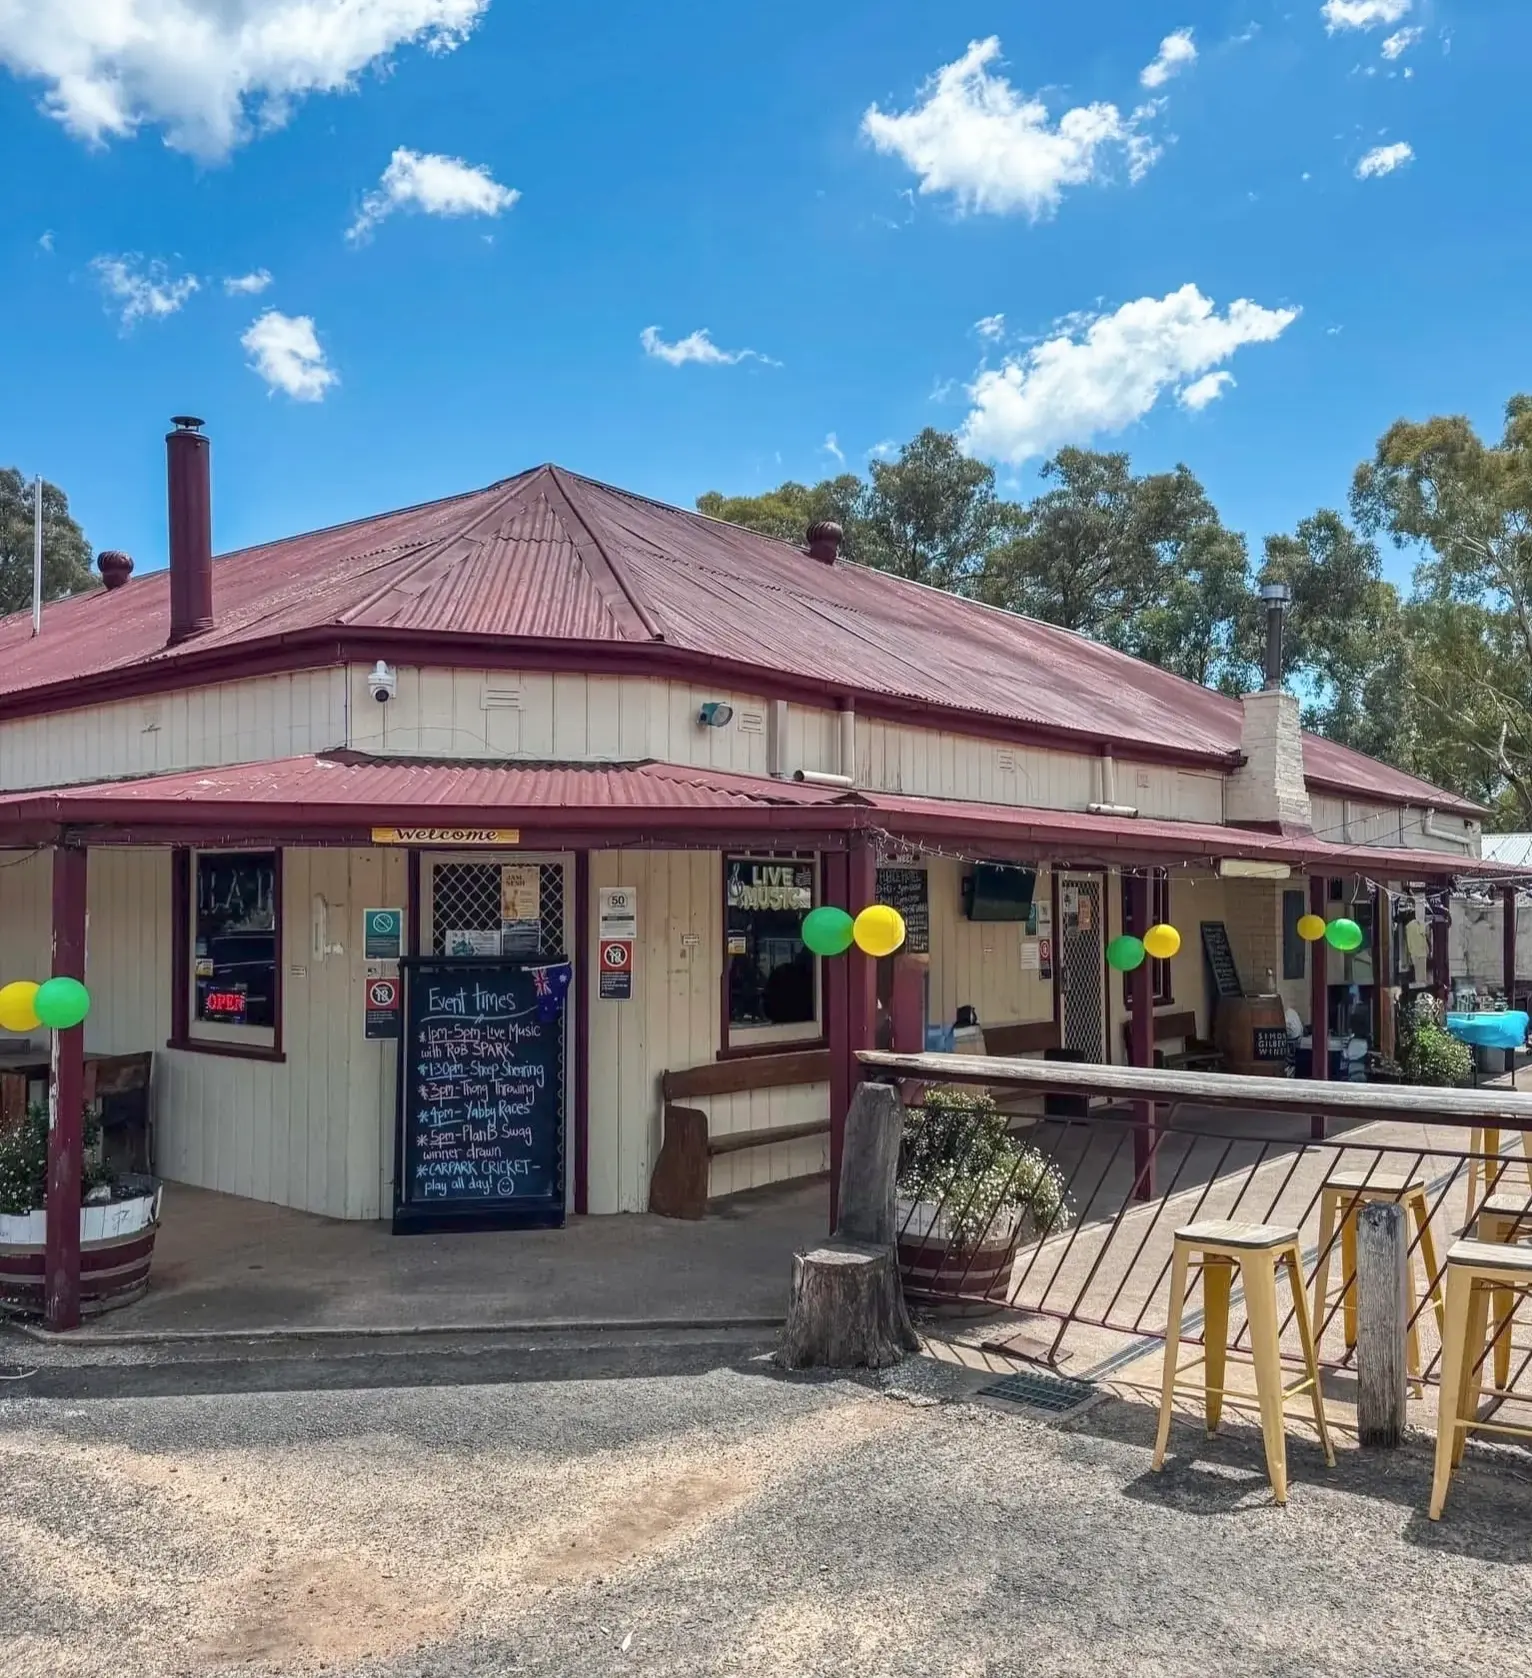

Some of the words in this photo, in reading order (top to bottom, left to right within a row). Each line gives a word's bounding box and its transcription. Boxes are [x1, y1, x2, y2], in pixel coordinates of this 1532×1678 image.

[395, 828, 498, 841] Welcome
[752, 865, 794, 887] LIVE
[611, 895, 625, 905] 50
[742, 886, 800, 911] MUSIC
[207, 993, 245, 1012] OPEN
[428, 986, 468, 1014] Event
[472, 982, 517, 1012] times
[509, 1021, 541, 1043] Music
[1258, 1032, 1287, 1040] SIMON
[420, 1046, 443, 1059] with
[472, 1043, 515, 1062] SPARK
[501, 1060, 545, 1088] Shearing
[490, 1078, 536, 1106] Throwing
[464, 1099, 498, 1127] Yabby
[499, 1099, 531, 1123] Races
[501, 1123, 533, 1147] Swag
[423, 1147, 460, 1160] winner
[466, 1142, 502, 1159] drawn
[428, 1161, 478, 1177] CARPARK
[424, 1180, 447, 1197] play
[451, 1179, 465, 1189] all
[468, 1174, 494, 1195] day!
